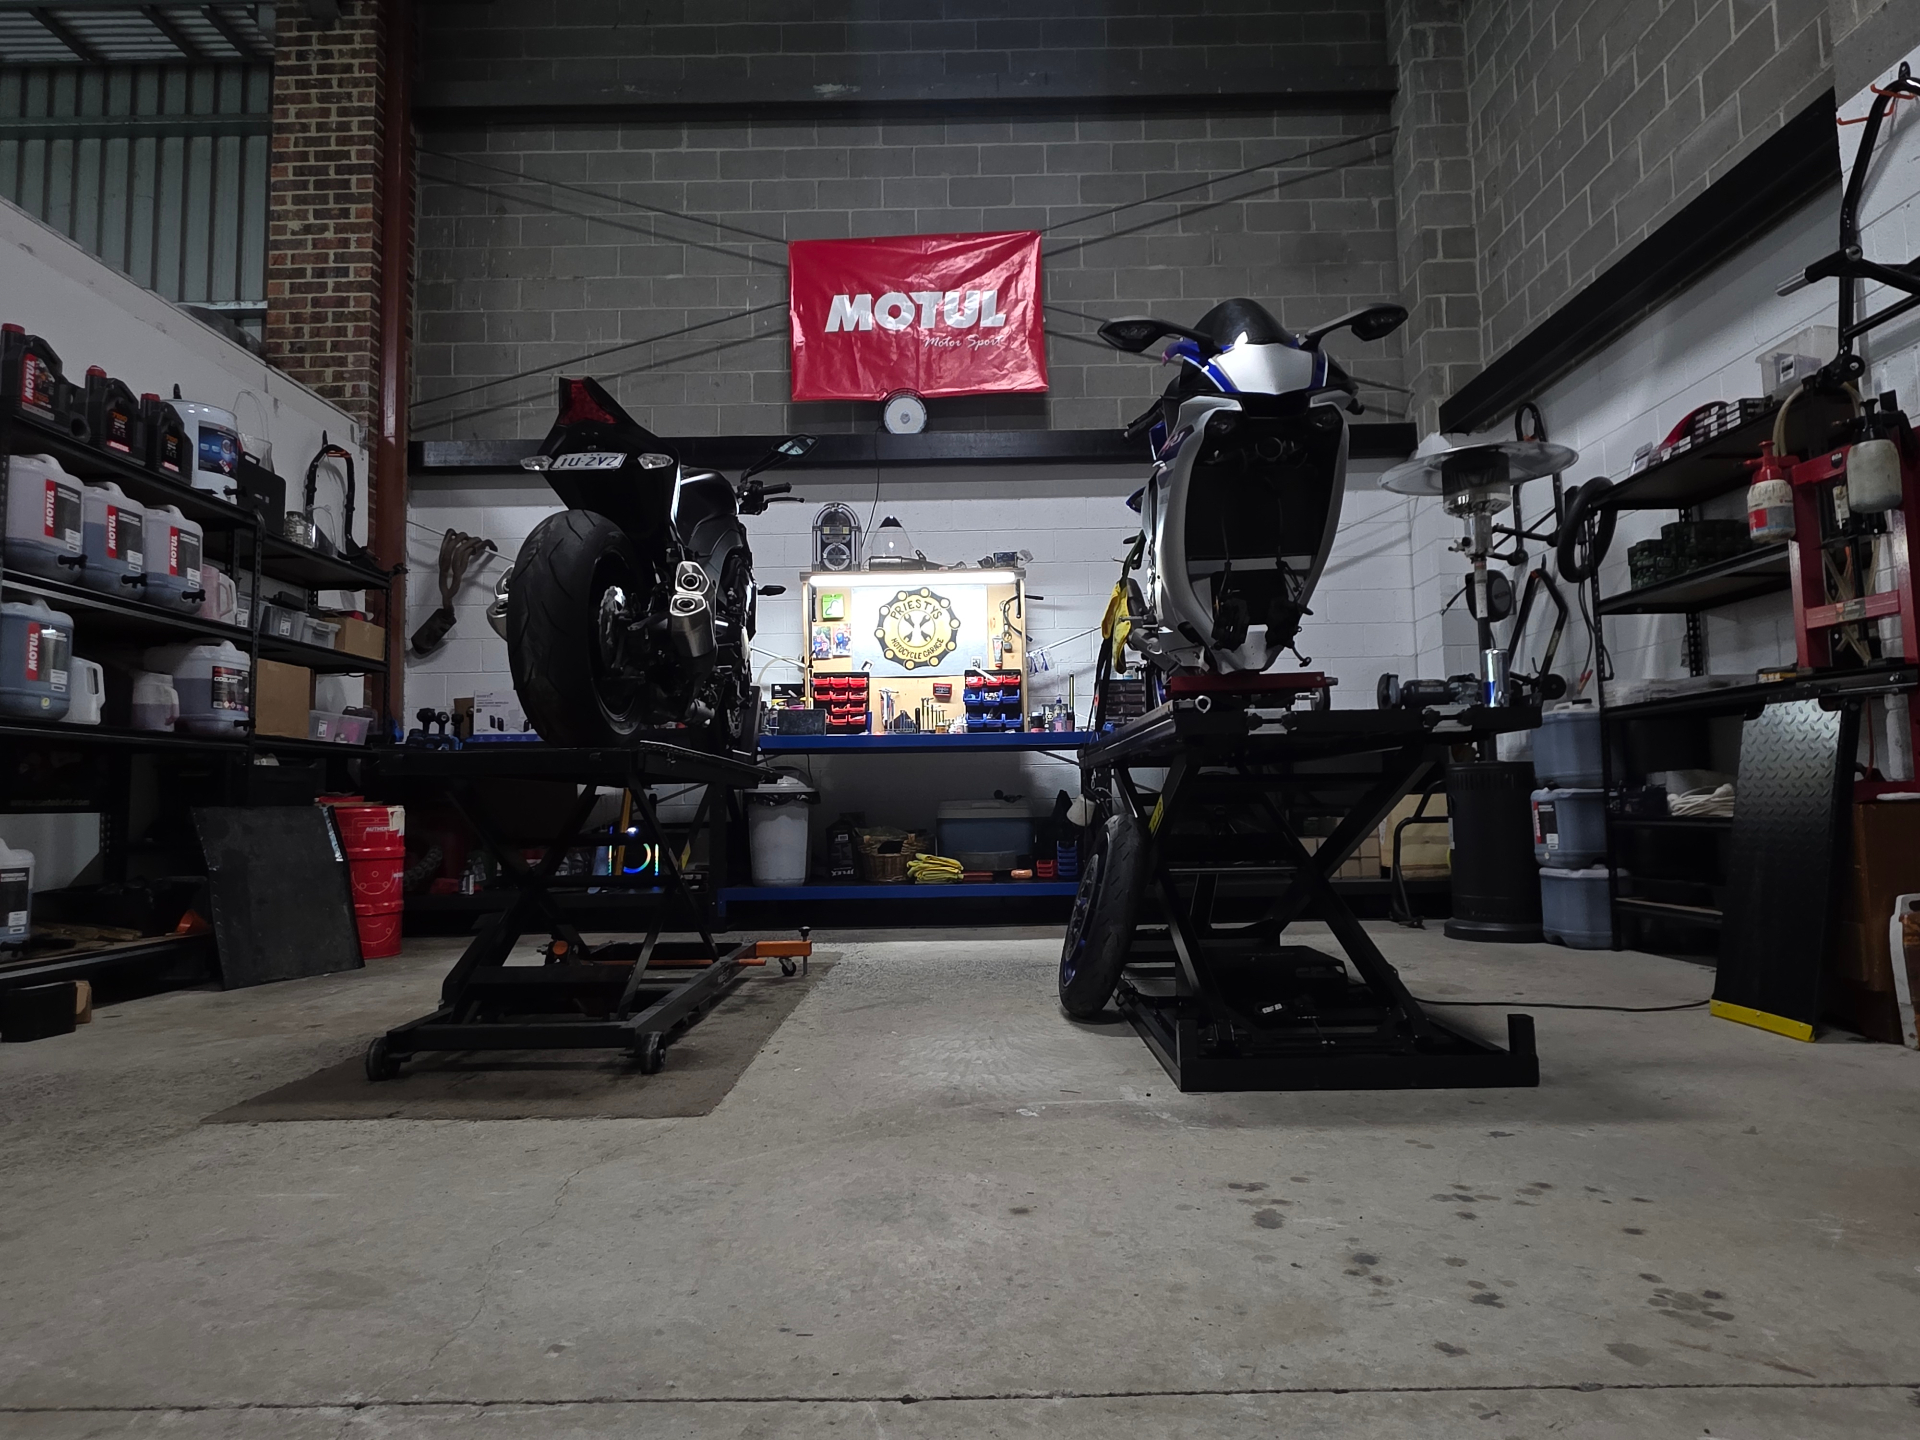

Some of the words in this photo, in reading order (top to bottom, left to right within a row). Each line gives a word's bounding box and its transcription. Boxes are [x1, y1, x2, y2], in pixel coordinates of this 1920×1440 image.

[825, 290, 1006, 333] MOTUL
[924, 336, 962, 348] Motor
[966, 334, 1004, 351] Sport
[24, 359, 35, 401] MOTUL
[45, 489, 55, 528] MOTUL
[108, 514, 116, 550] MOTUL
[170, 535, 178, 568] MOTUL
[28, 632, 39, 672] MOTUL
[922, 638, 944, 658] GARAGE
